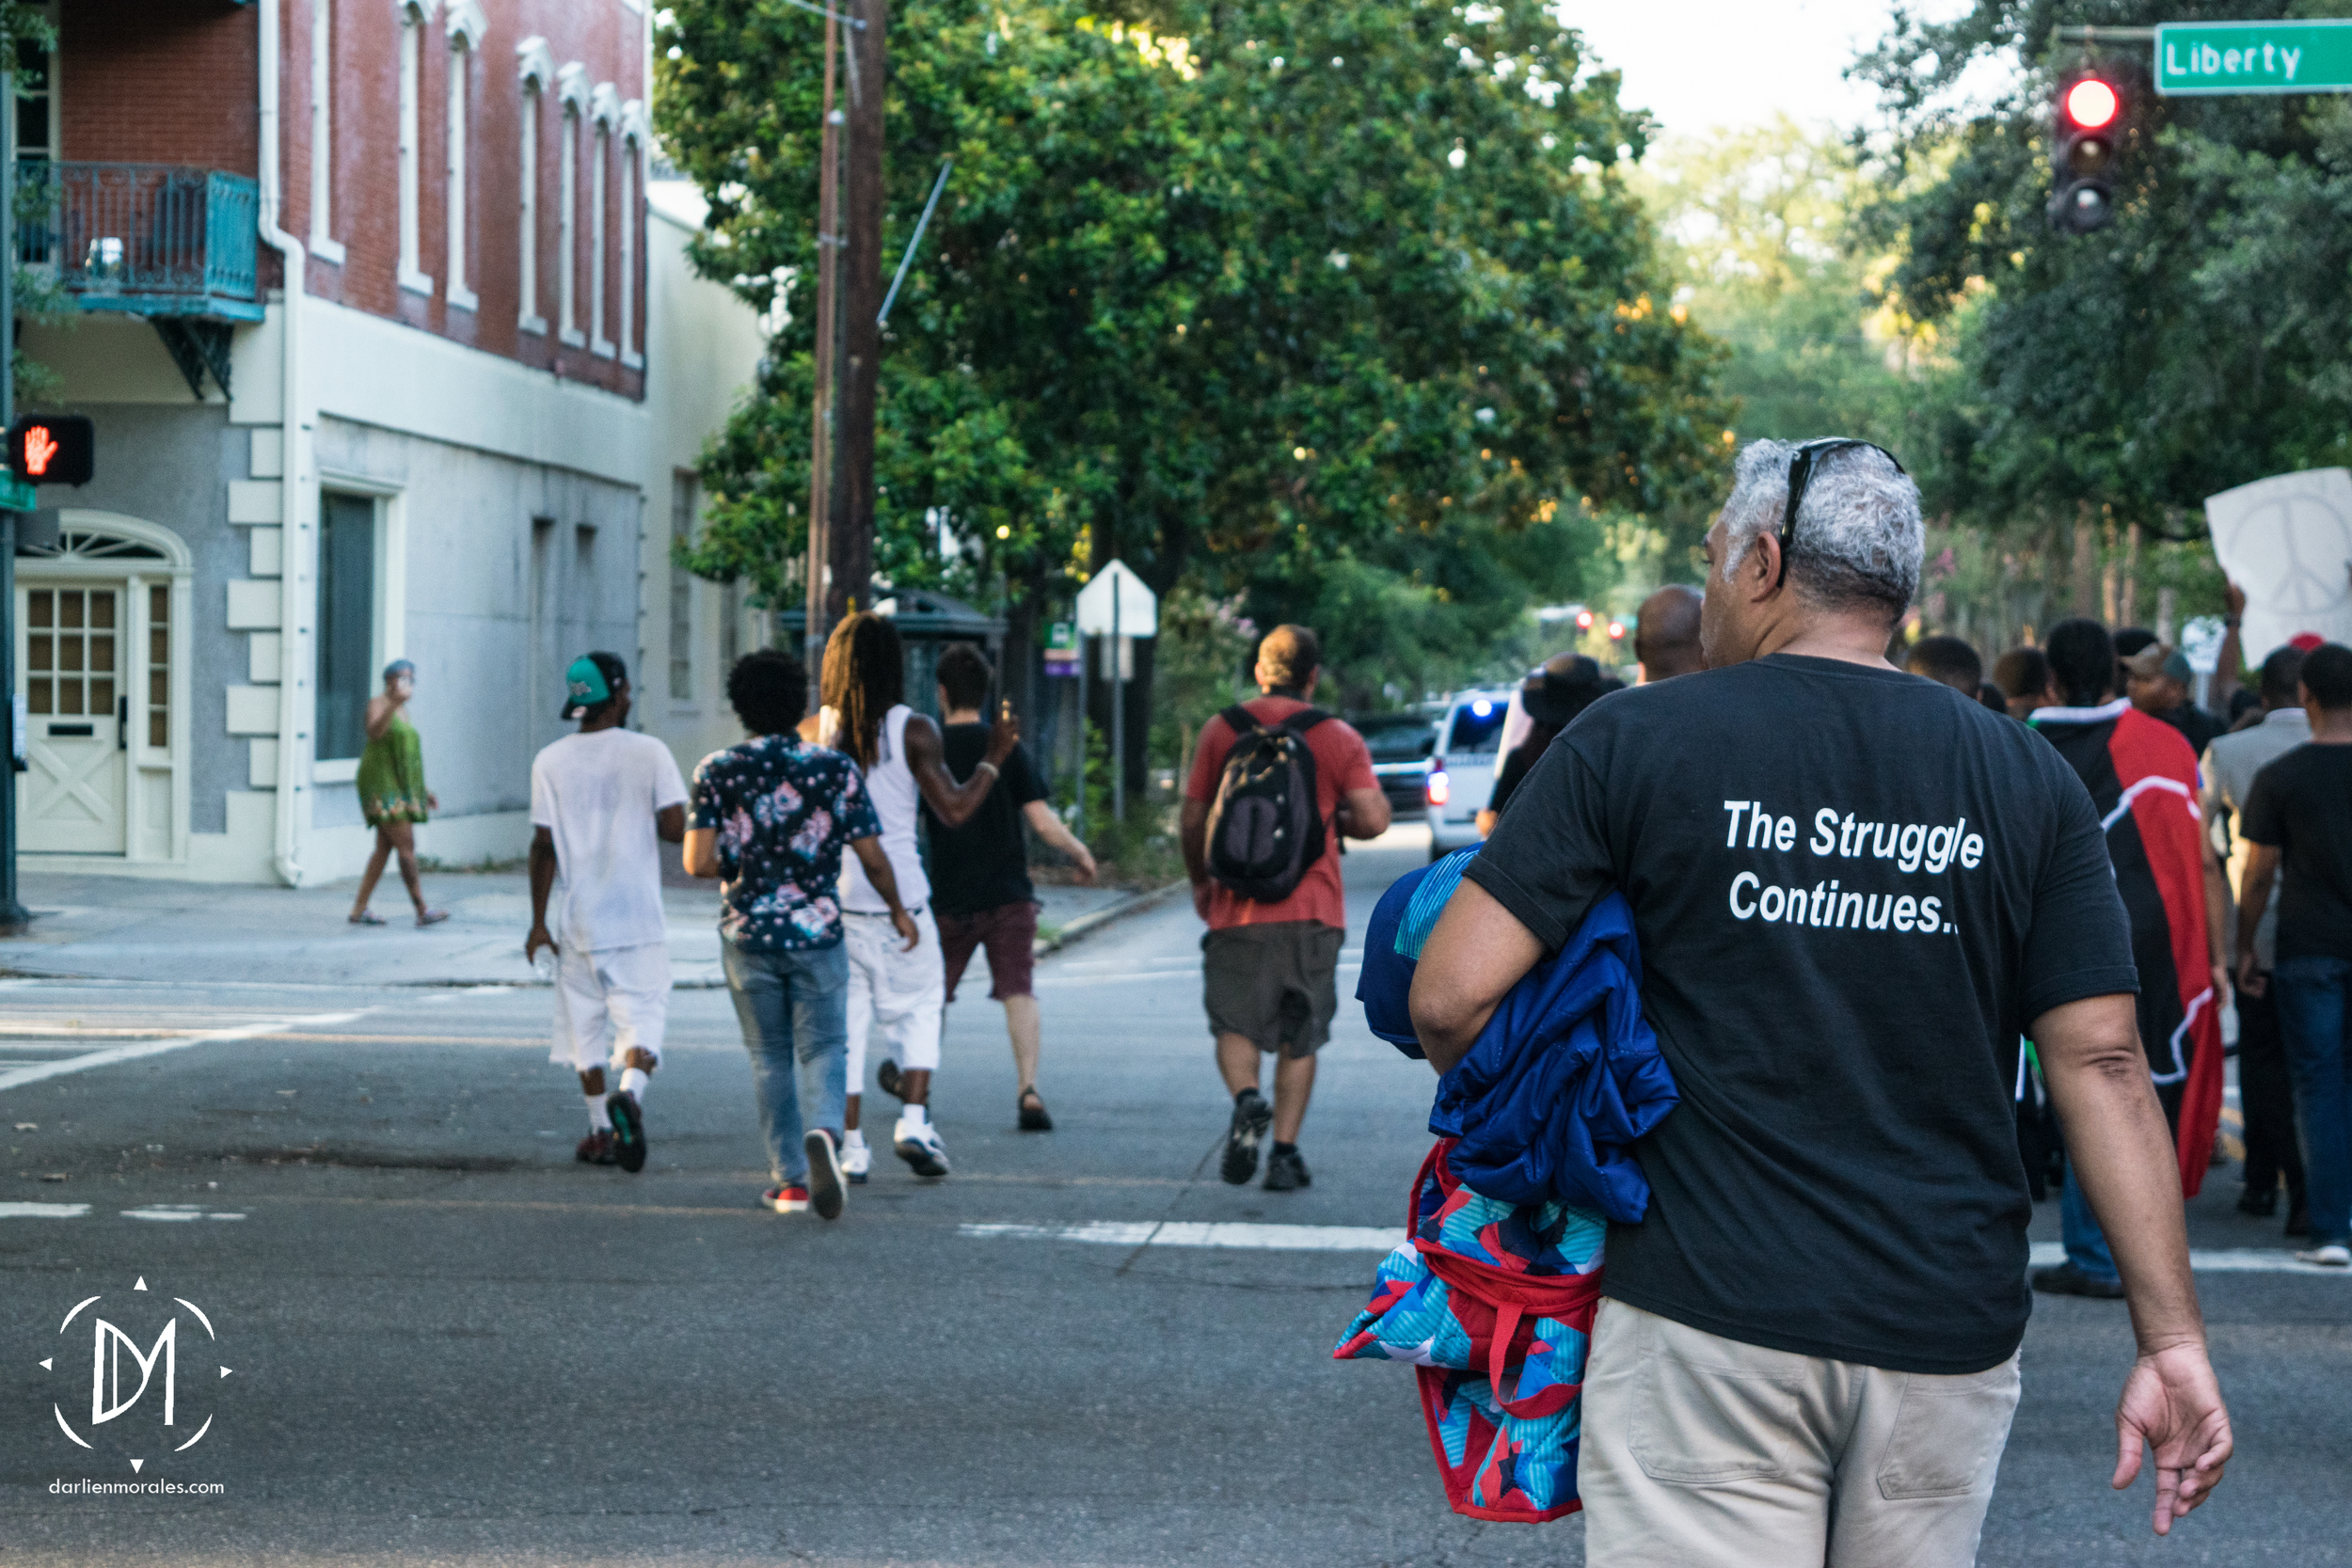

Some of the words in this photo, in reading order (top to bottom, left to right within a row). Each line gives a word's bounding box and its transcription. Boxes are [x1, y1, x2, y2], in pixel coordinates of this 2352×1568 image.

[2166, 41, 2302, 82] Liberty
[1724, 800, 1797, 852] The
[1809, 807, 1985, 875] Struggle
